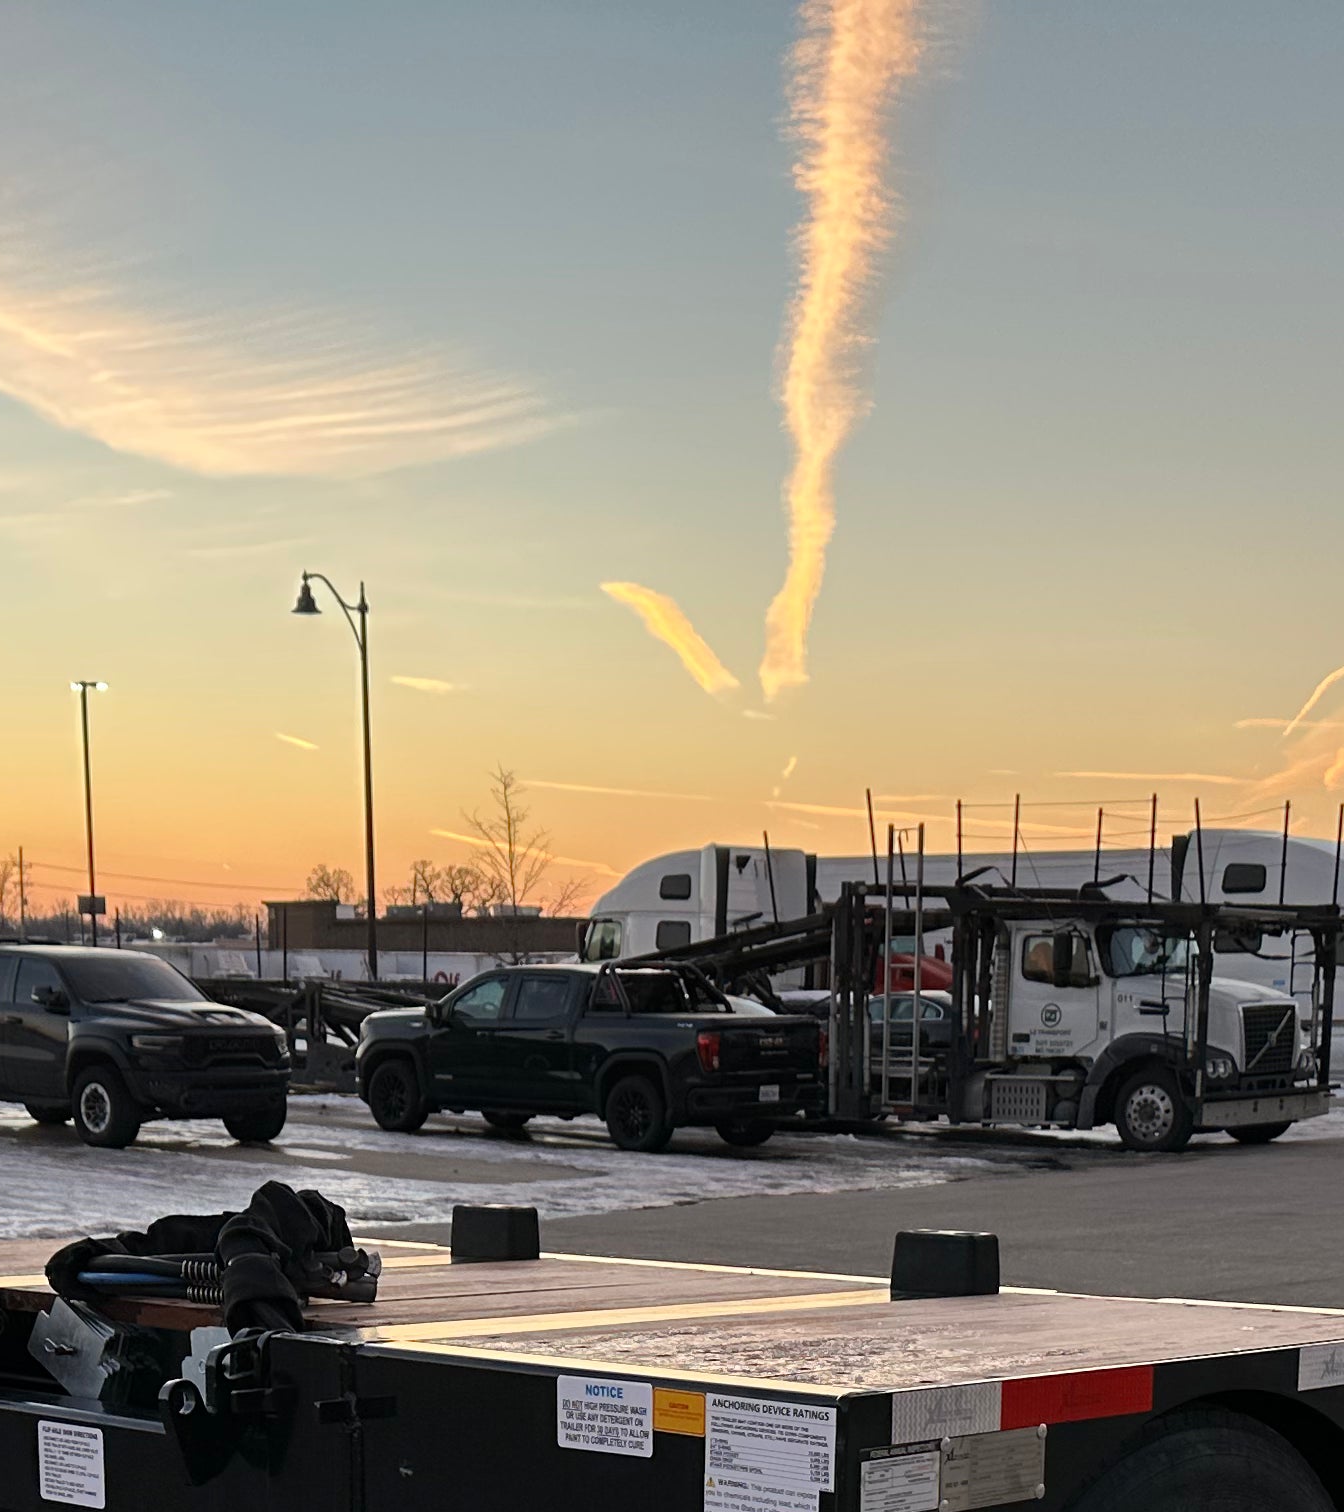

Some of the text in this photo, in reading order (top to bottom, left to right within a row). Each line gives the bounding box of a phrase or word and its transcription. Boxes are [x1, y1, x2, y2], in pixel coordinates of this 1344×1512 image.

[1117, 994, 1133, 1003] 011
[585, 1384, 624, 1399] NOTICE
[599, 1402, 629, 1414] PRESSURE
[711, 1398, 830, 1421] ANCHORING DEVICE RATINGS
[566, 1411, 643, 1427] OR USE ANY DETERGENT ON
[560, 1421, 583, 1431] TRAILER
[585, 1423, 596, 1433] FOR
[605, 1426, 619, 1436] DAYS
[620, 1428, 628, 1437] TO
[629, 1429, 649, 1439] ALLOW
[582, 1435, 589, 1443] TO
[591, 1436, 627, 1448] COMPLETELY
[628, 1440, 644, 1450] CURE
